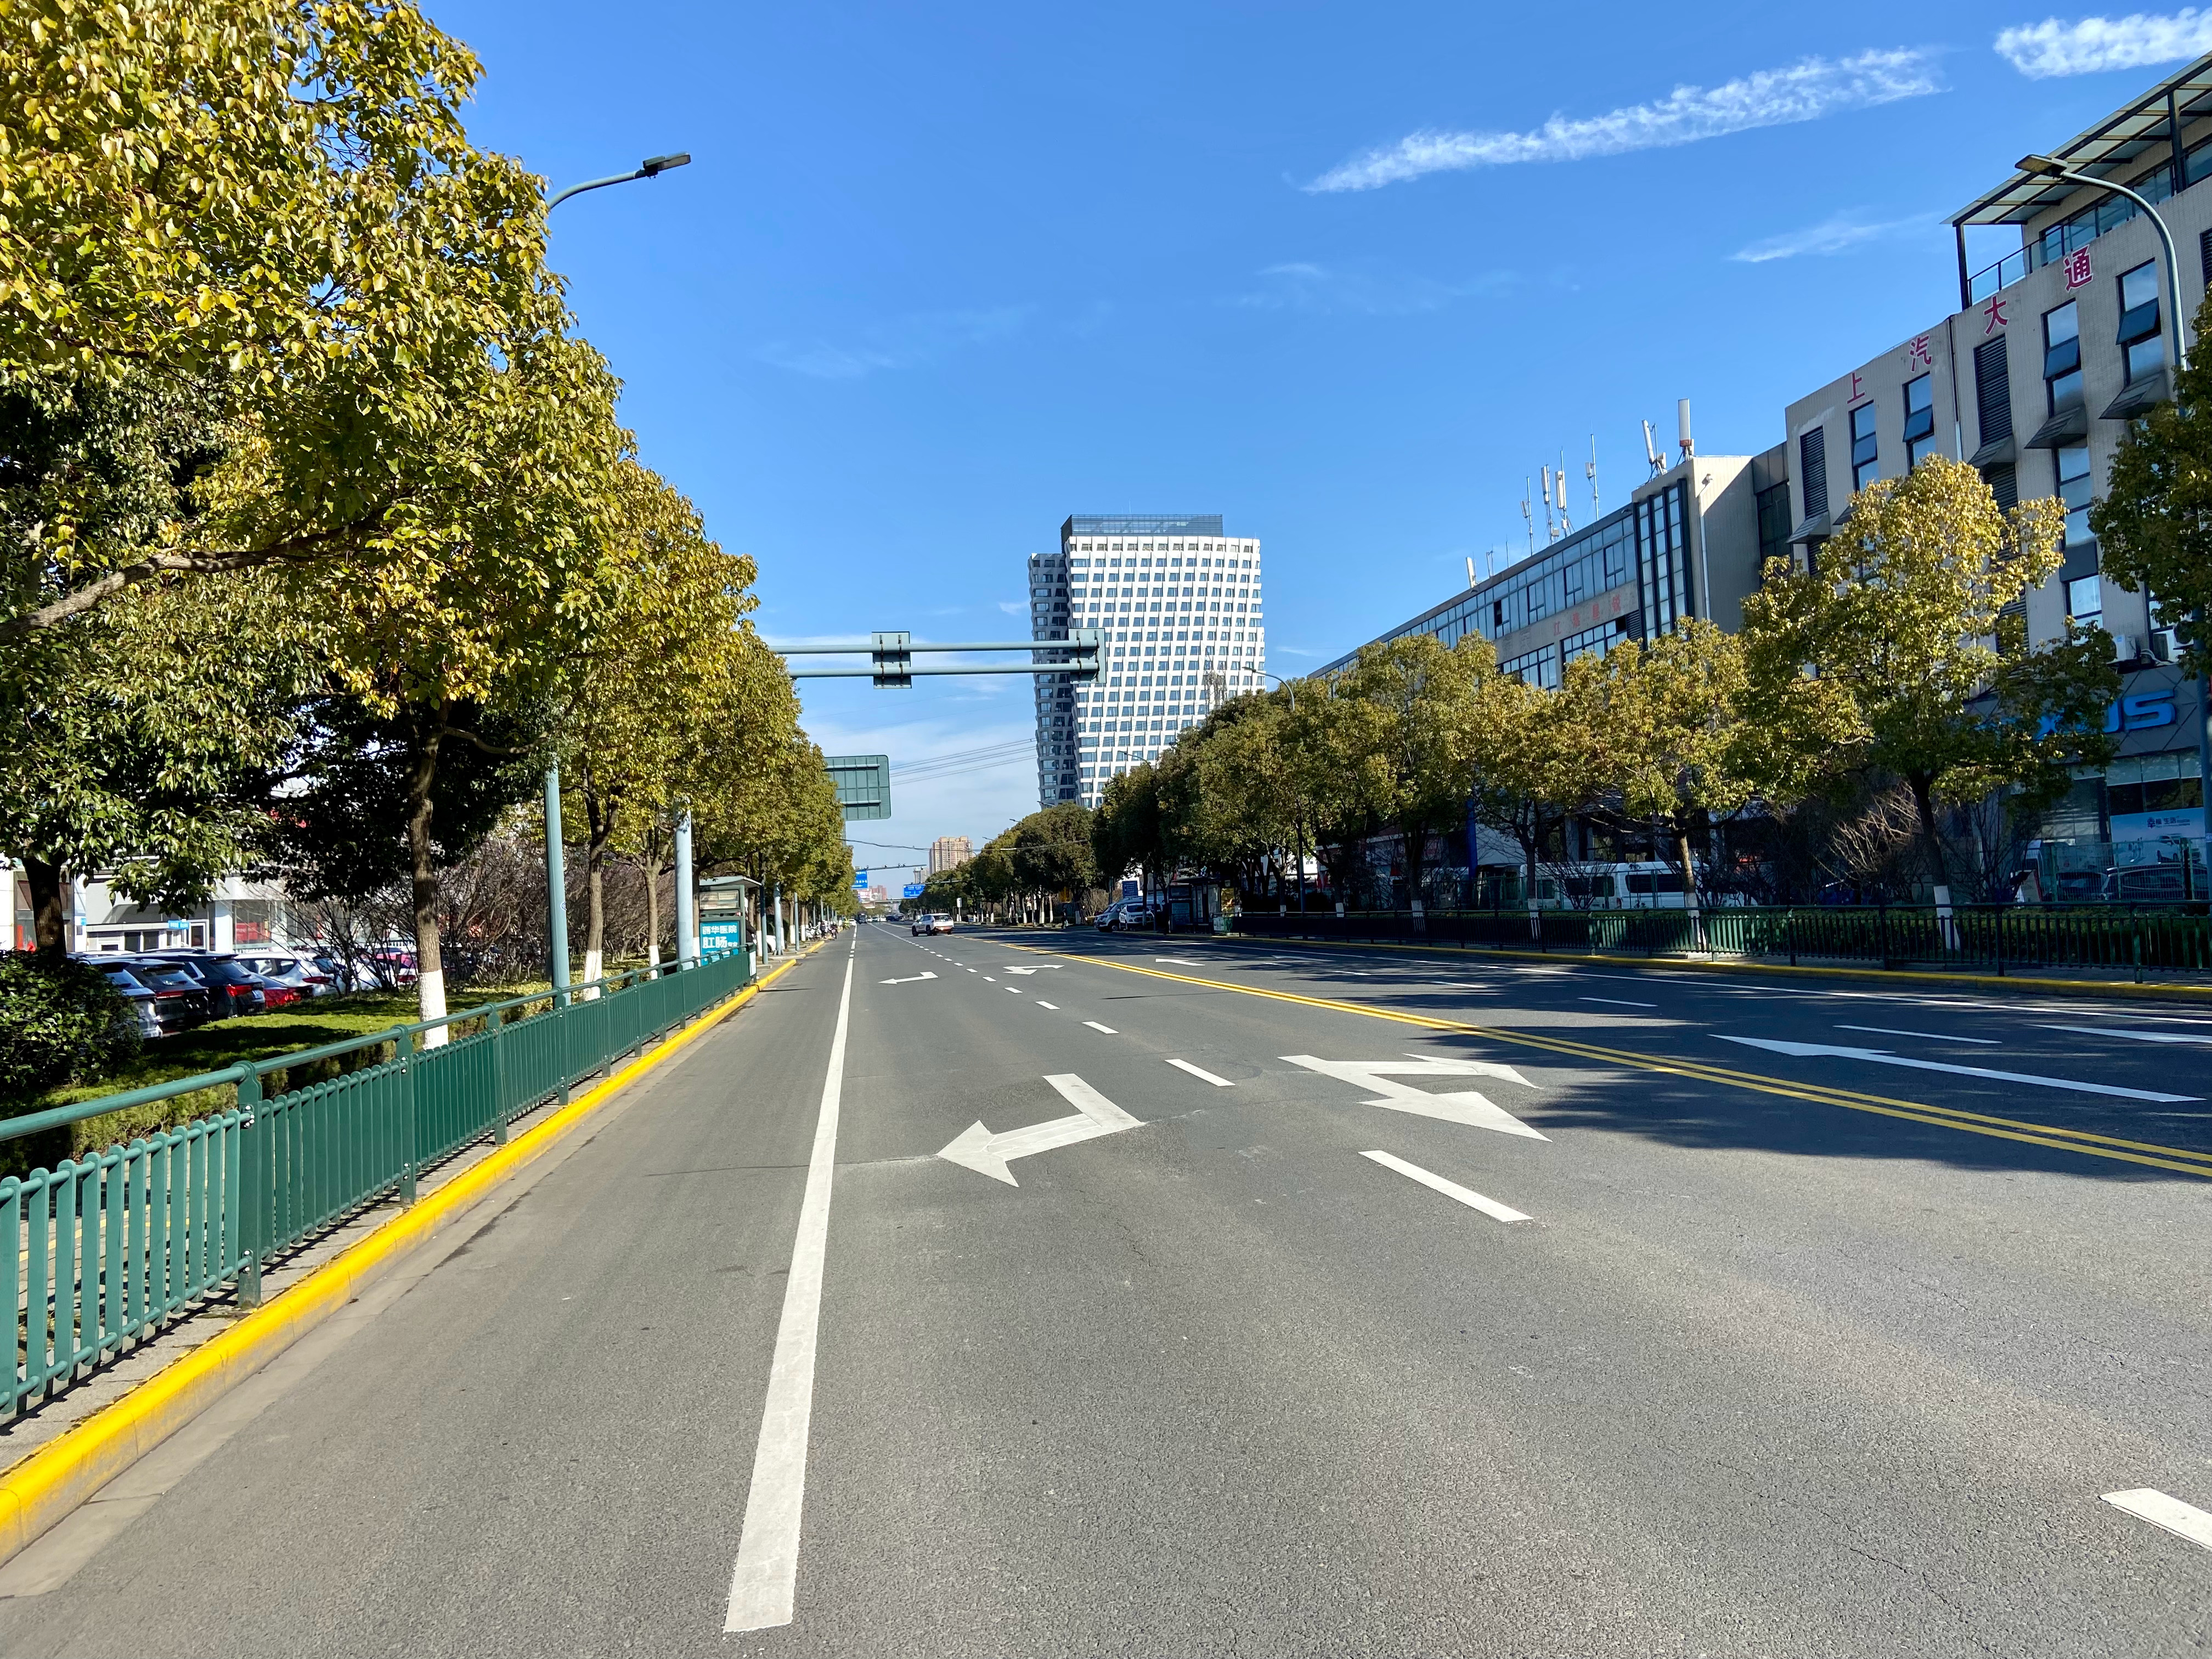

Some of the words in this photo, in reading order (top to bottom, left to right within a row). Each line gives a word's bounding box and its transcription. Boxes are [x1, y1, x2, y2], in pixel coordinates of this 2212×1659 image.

[1847, 244, 2094, 404] 上汽大通
[702, 925, 737, 935] 丽华医院
[703, 936, 727, 949] 肛肠
